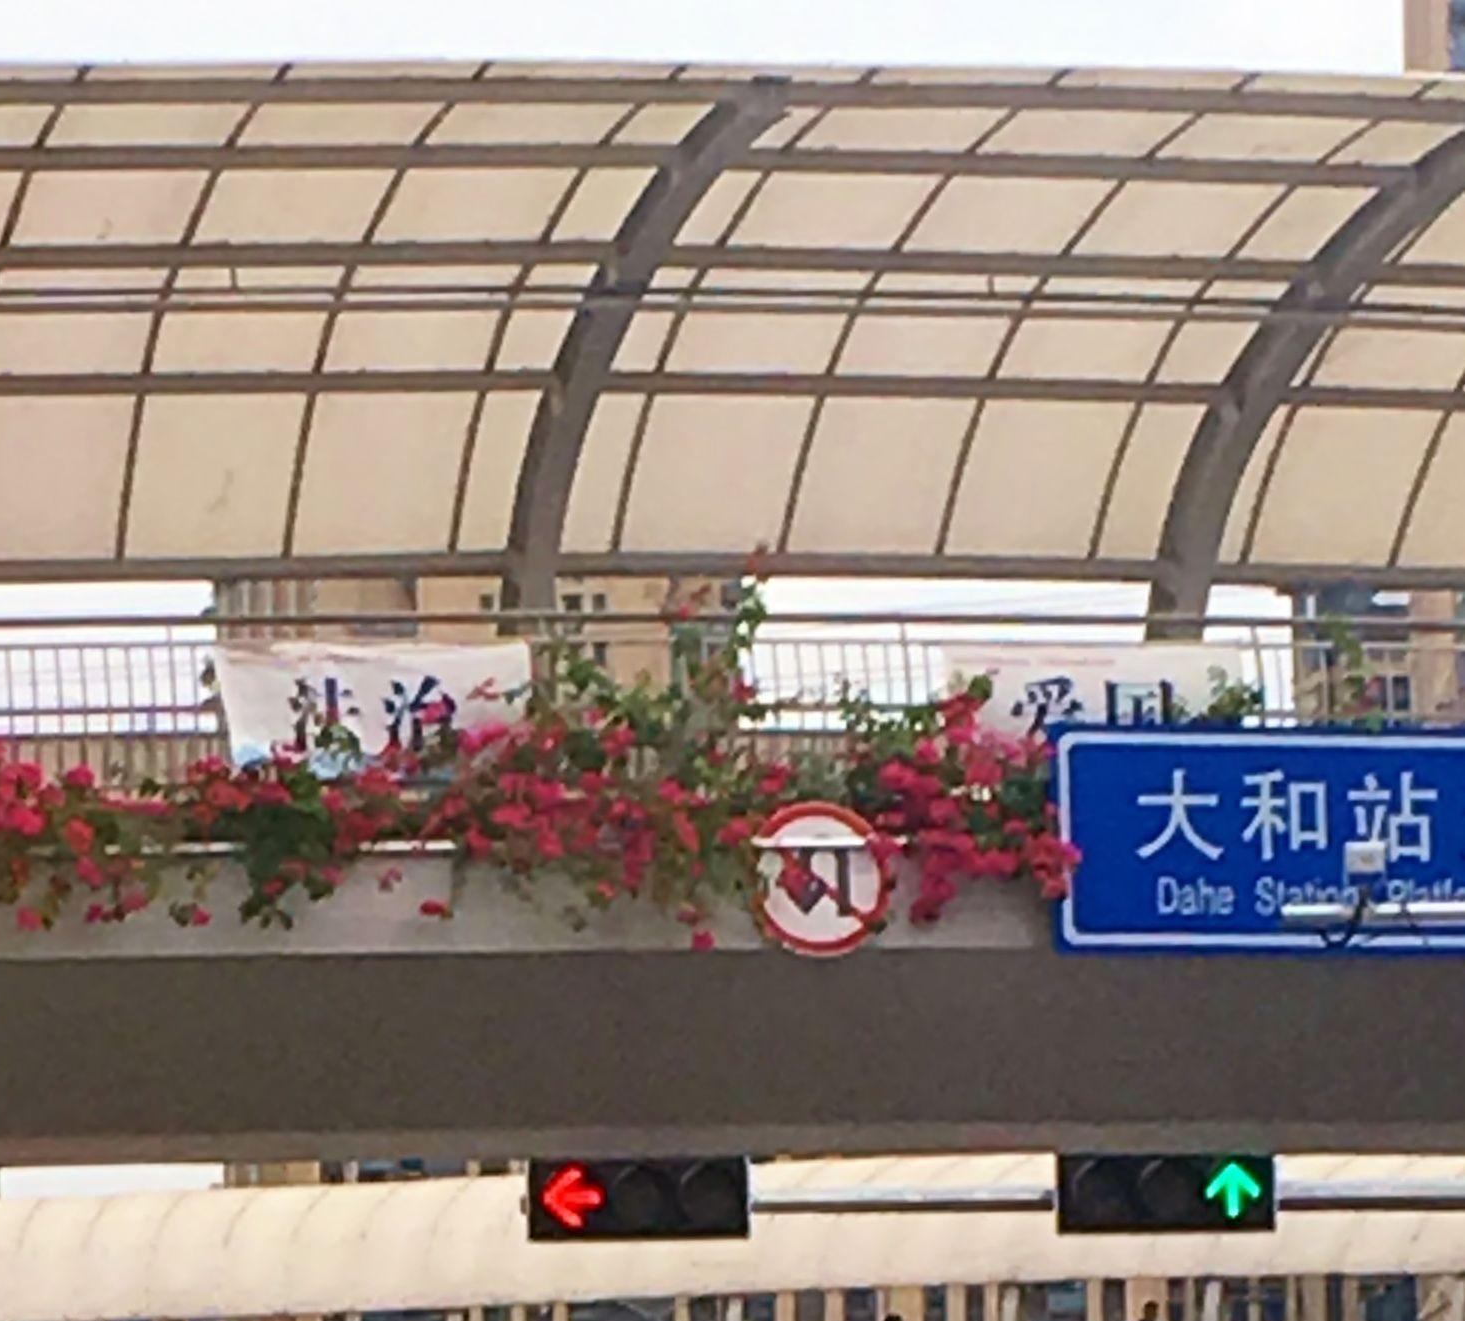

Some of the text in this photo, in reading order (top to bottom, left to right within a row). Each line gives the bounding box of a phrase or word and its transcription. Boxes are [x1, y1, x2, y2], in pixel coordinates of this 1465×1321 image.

[1135, 768, 1438, 862] 大和站
[1156, 876, 1234, 915] Dahe
